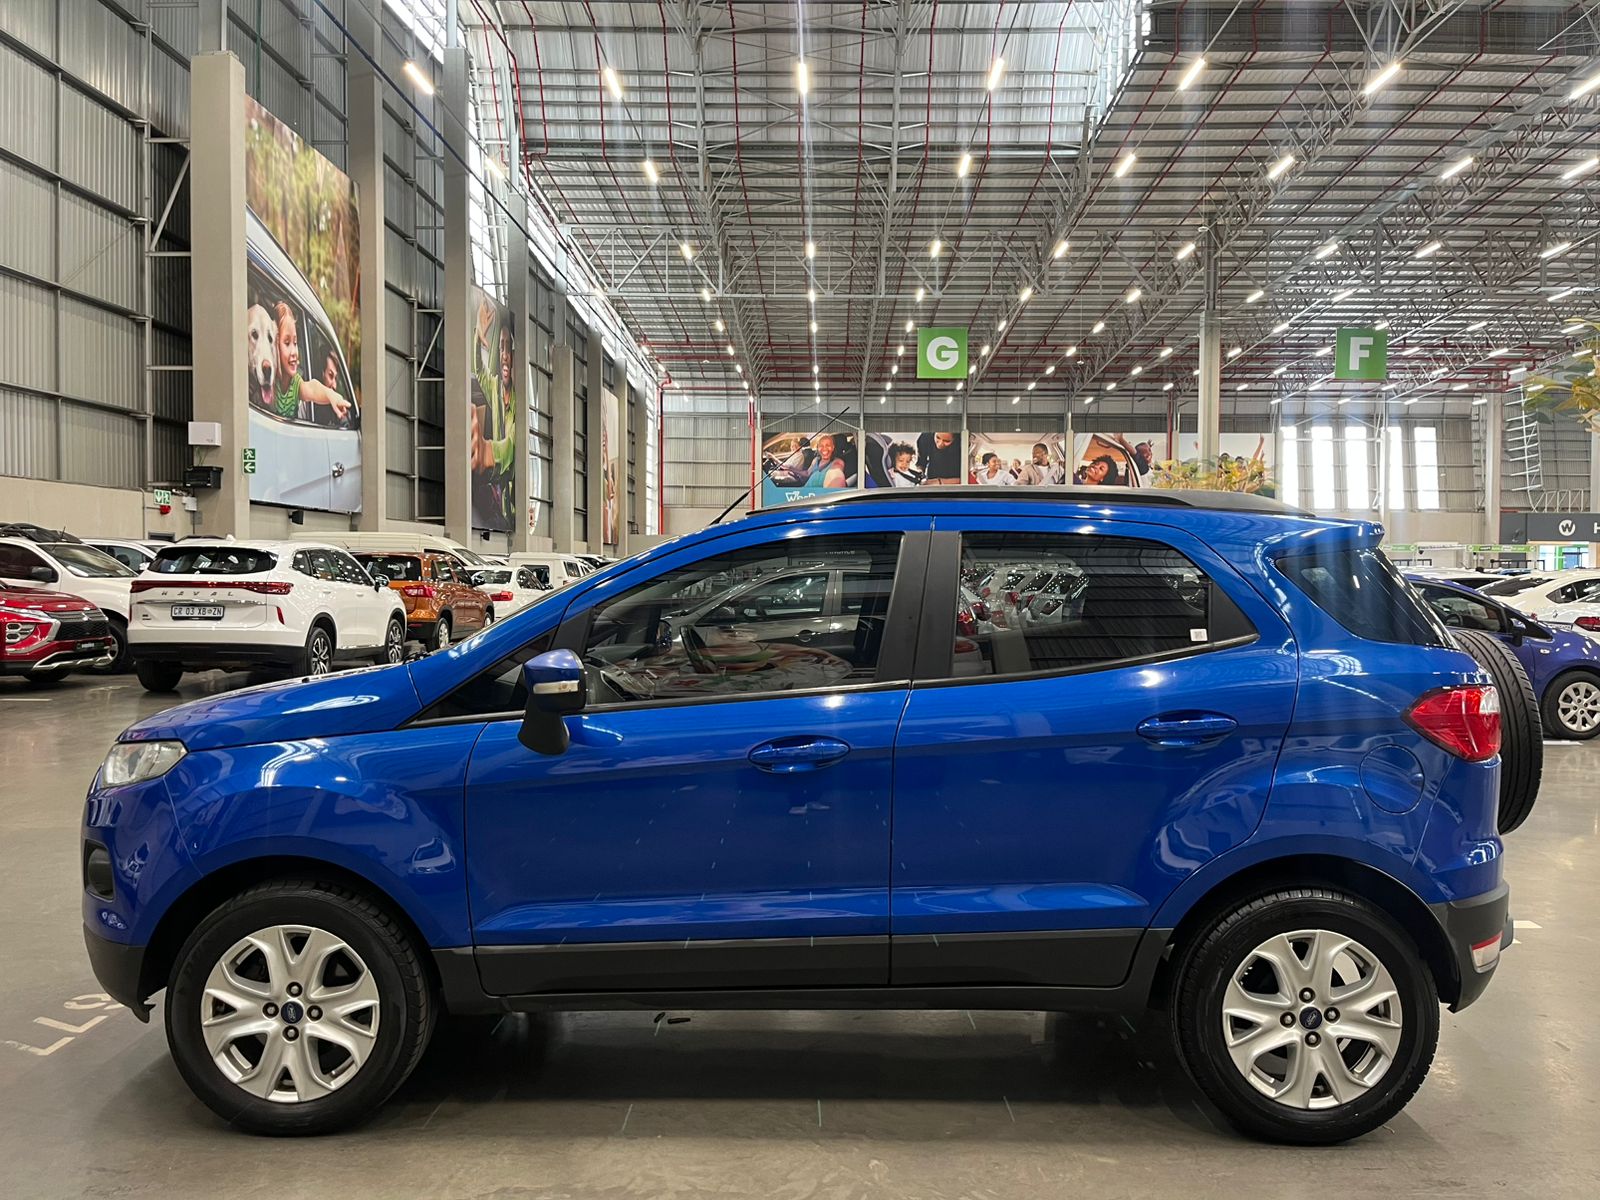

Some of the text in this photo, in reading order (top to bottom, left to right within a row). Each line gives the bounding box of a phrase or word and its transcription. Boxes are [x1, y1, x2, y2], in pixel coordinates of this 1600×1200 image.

[926, 336, 959, 371] G
[1349, 336, 1374, 371] F
[212, 607, 222, 616] ZN
